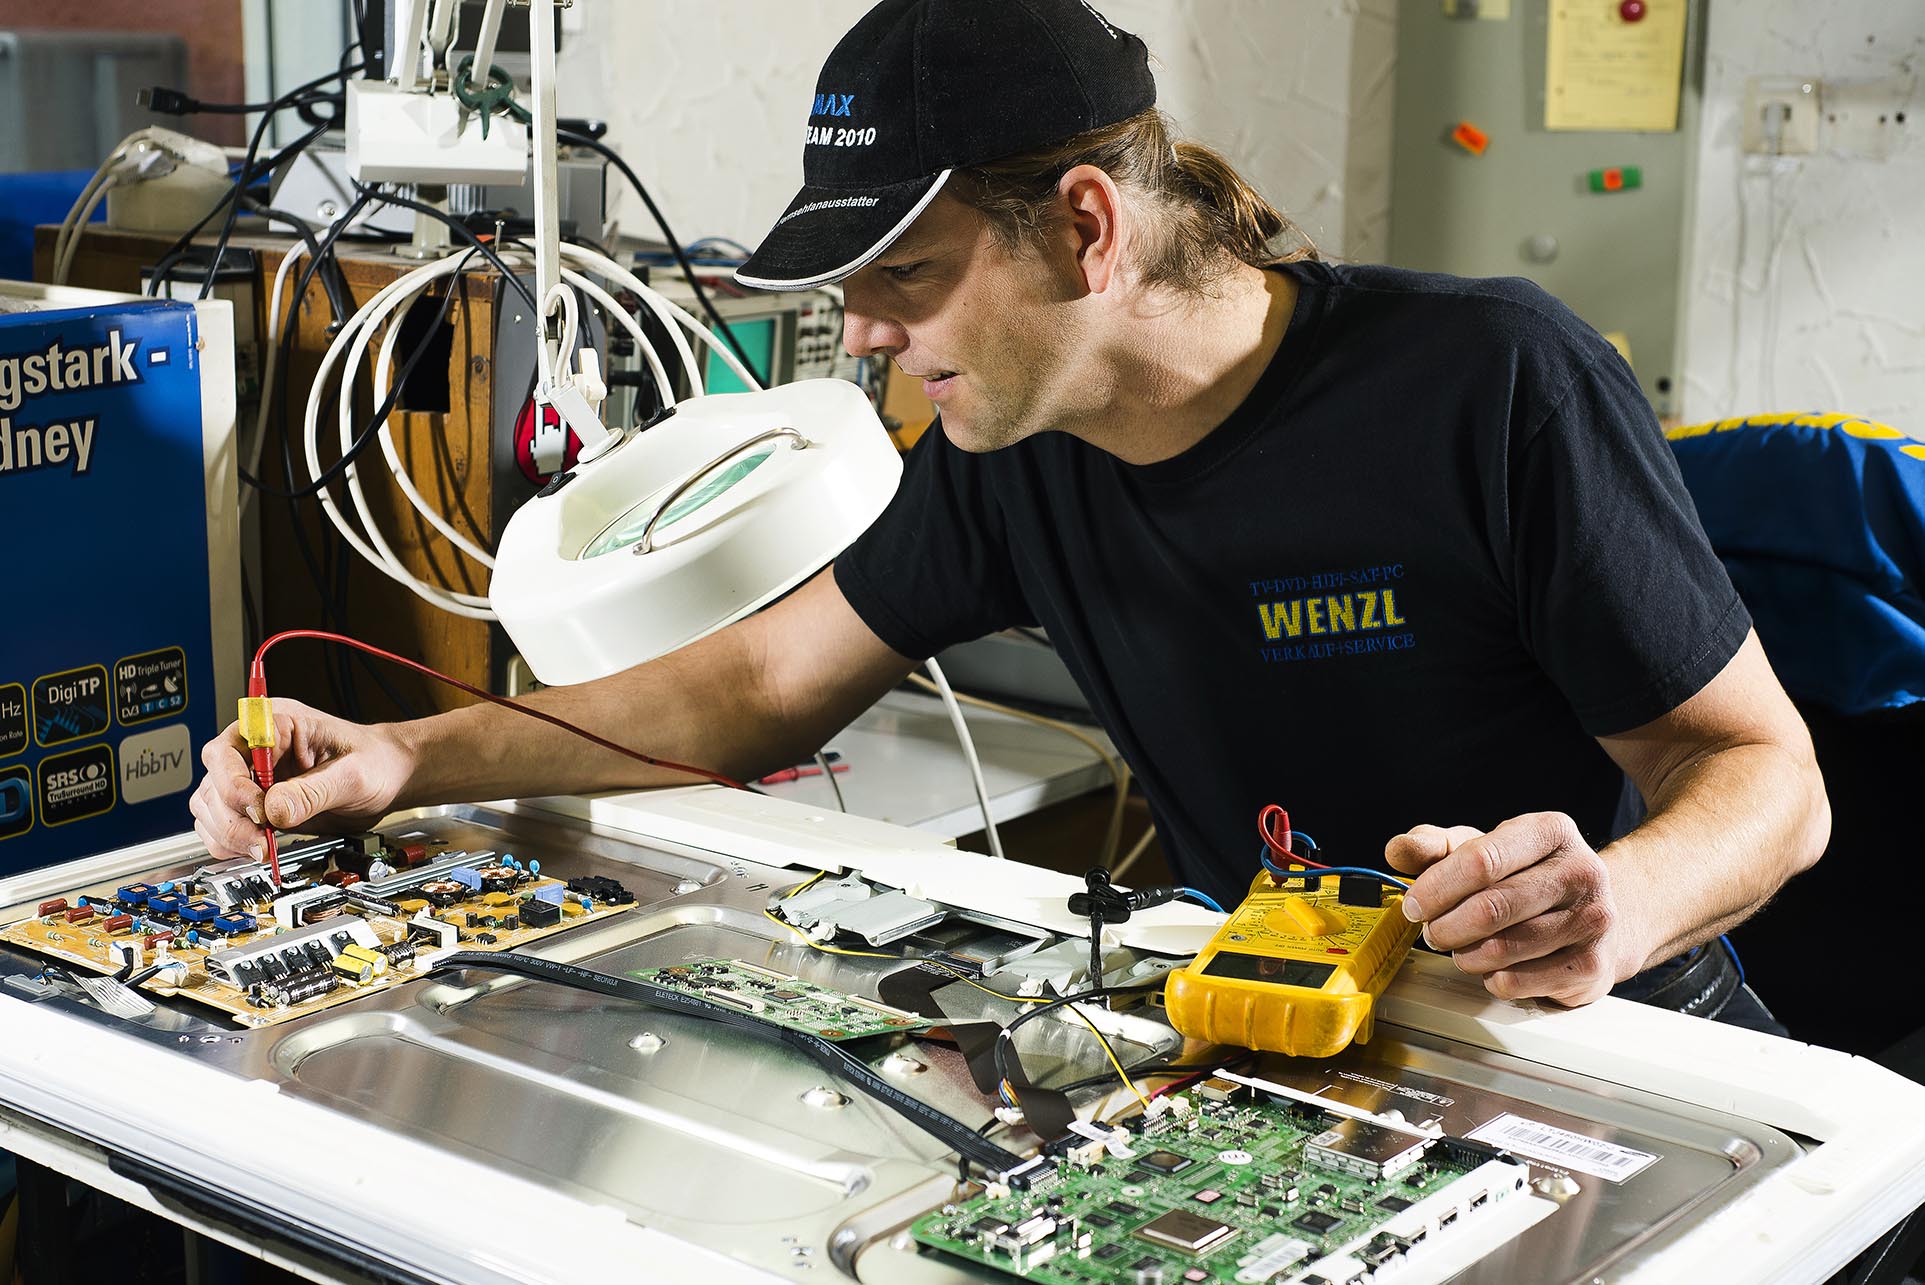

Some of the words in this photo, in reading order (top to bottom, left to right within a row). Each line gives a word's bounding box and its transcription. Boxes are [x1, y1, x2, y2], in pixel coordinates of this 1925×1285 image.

[834, 127, 877, 147] 2010
[0, 330, 138, 411] gstark
[0, 417, 95, 472] dney
[1258, 588, 1406, 640] WENZL
[119, 664, 136, 681] HD
[137, 663, 160, 677] Triple
[160, 659, 182, 672] Tuner
[1, 701, 22, 719] Hz
[125, 749, 184, 781] HbbTV
[46, 769, 79, 790] SRS
[49, 784, 94, 801] TruSurround
[94, 779, 106, 791] HD
